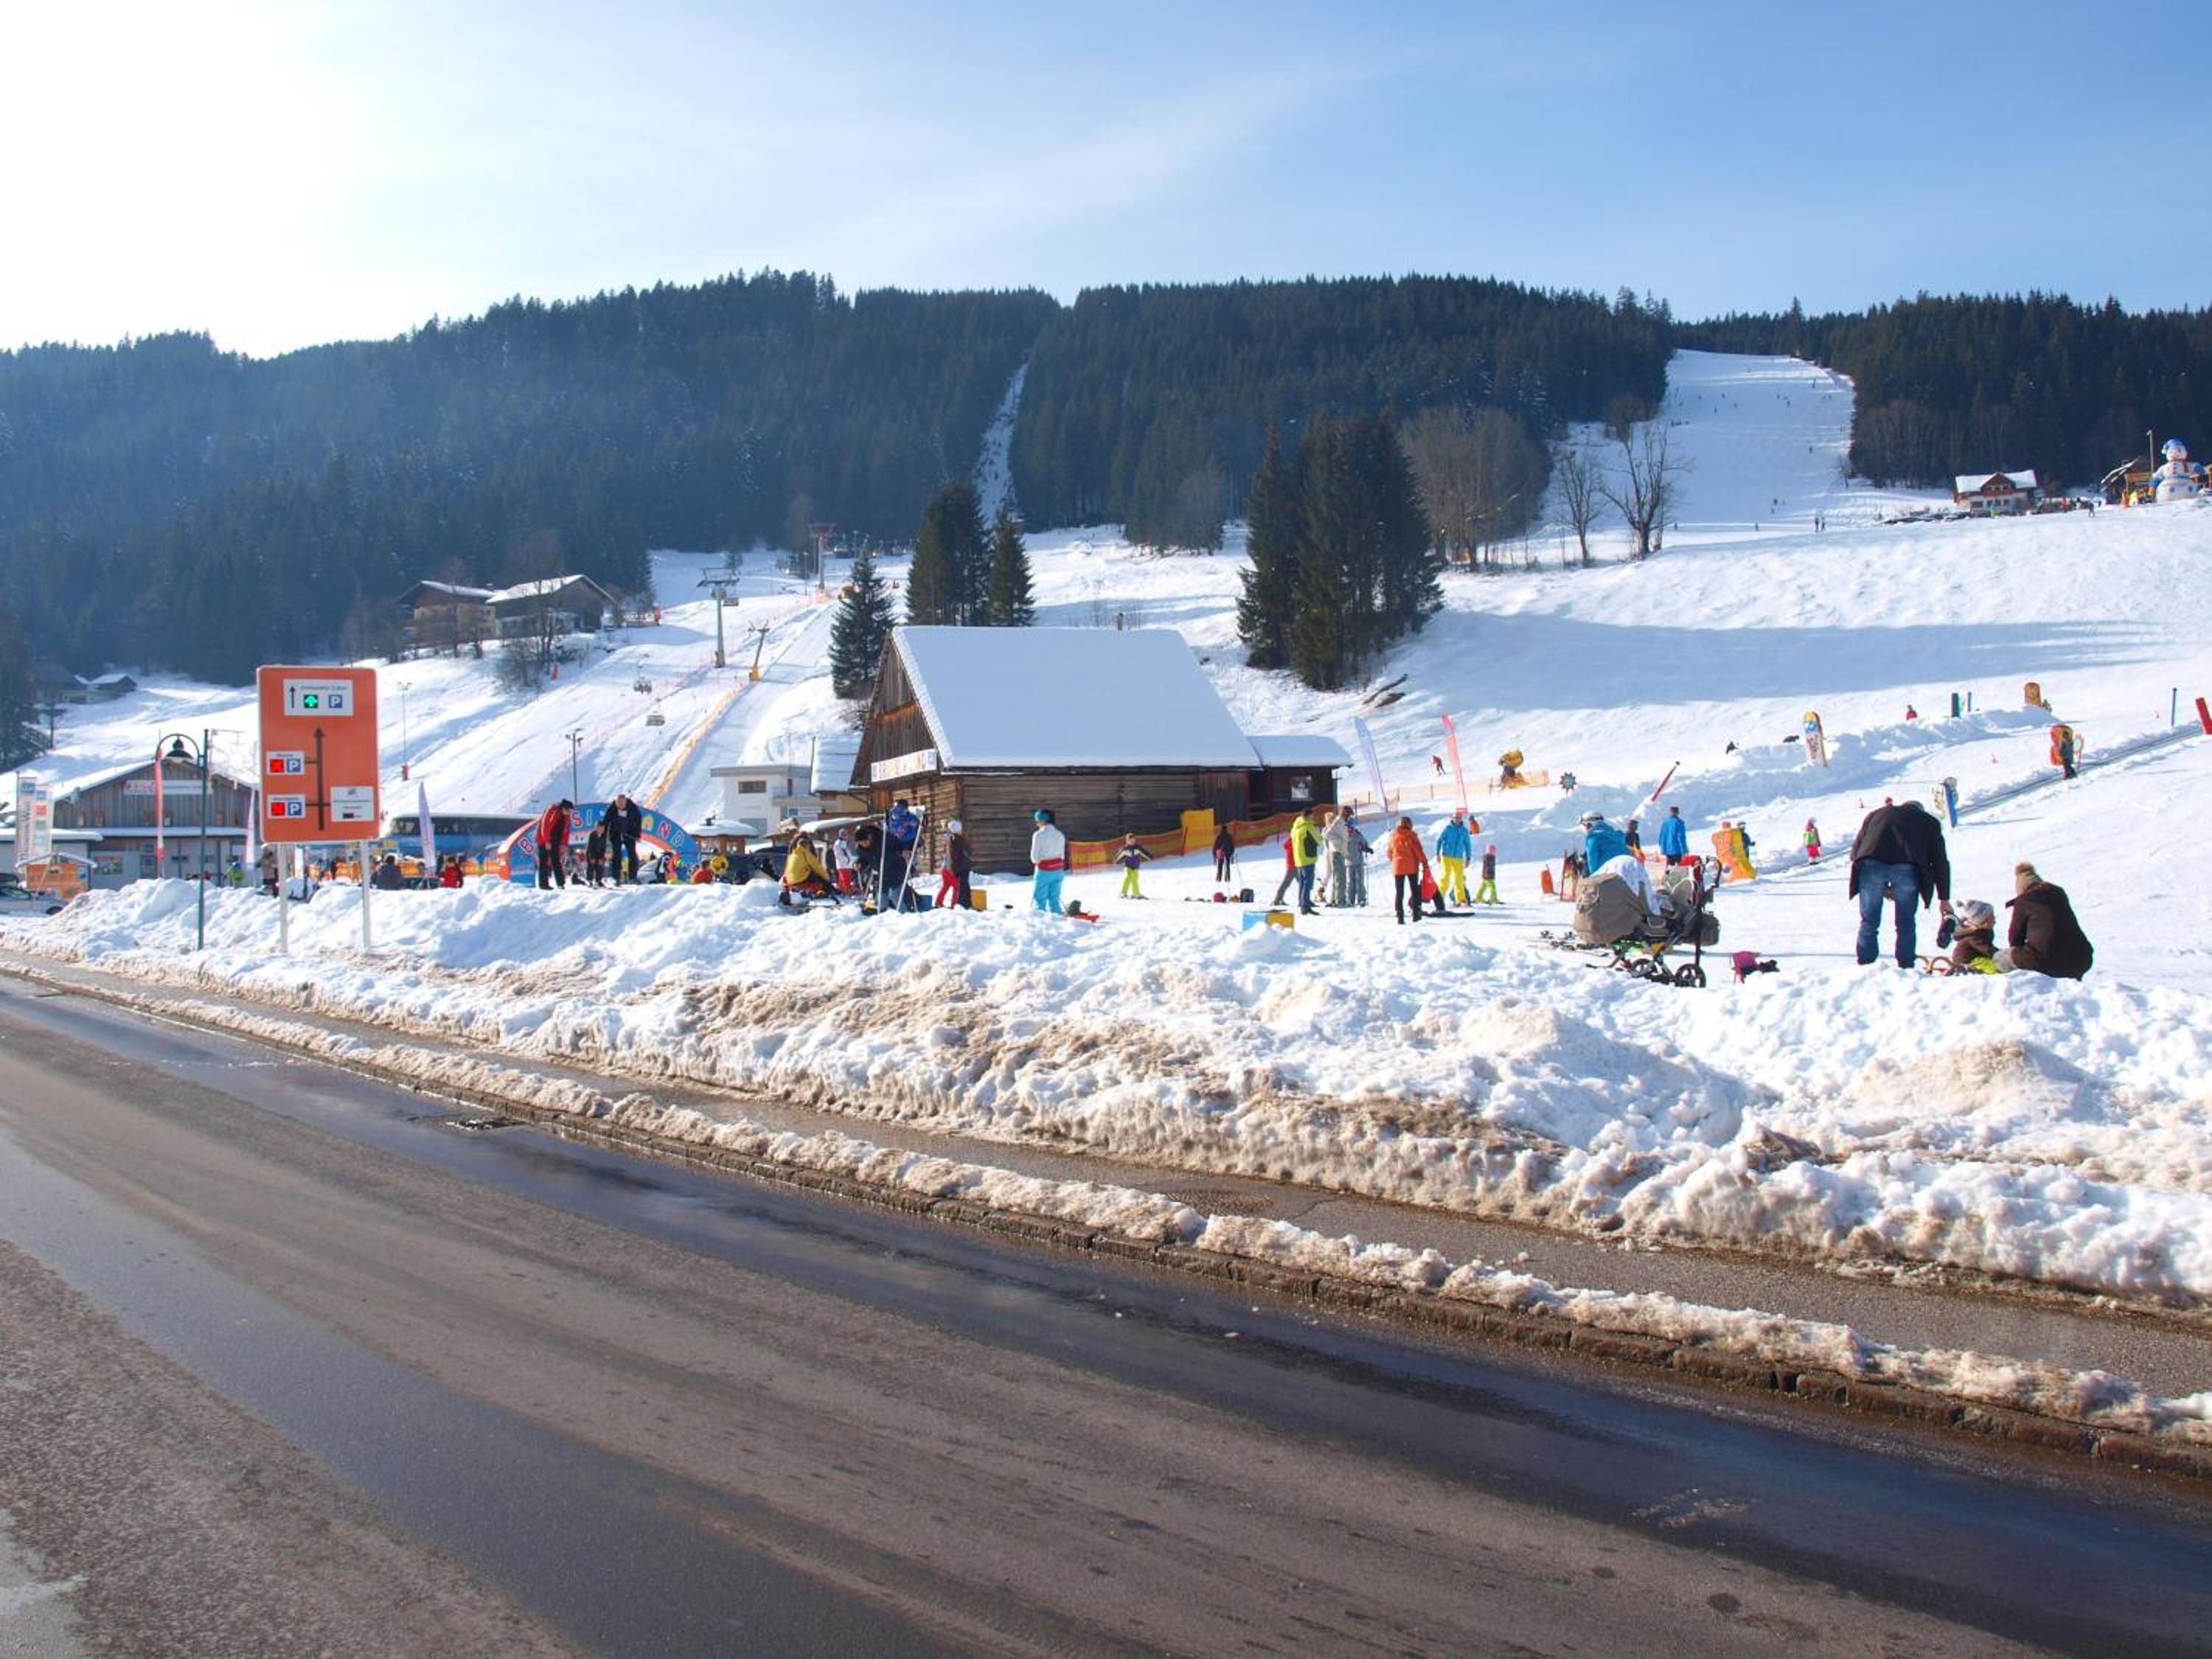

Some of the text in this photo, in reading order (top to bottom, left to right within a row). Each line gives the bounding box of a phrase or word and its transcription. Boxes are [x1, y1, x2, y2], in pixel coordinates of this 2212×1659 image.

[331, 695, 341, 707] P
[288, 760, 299, 771] P
[290, 803, 299, 815] P
